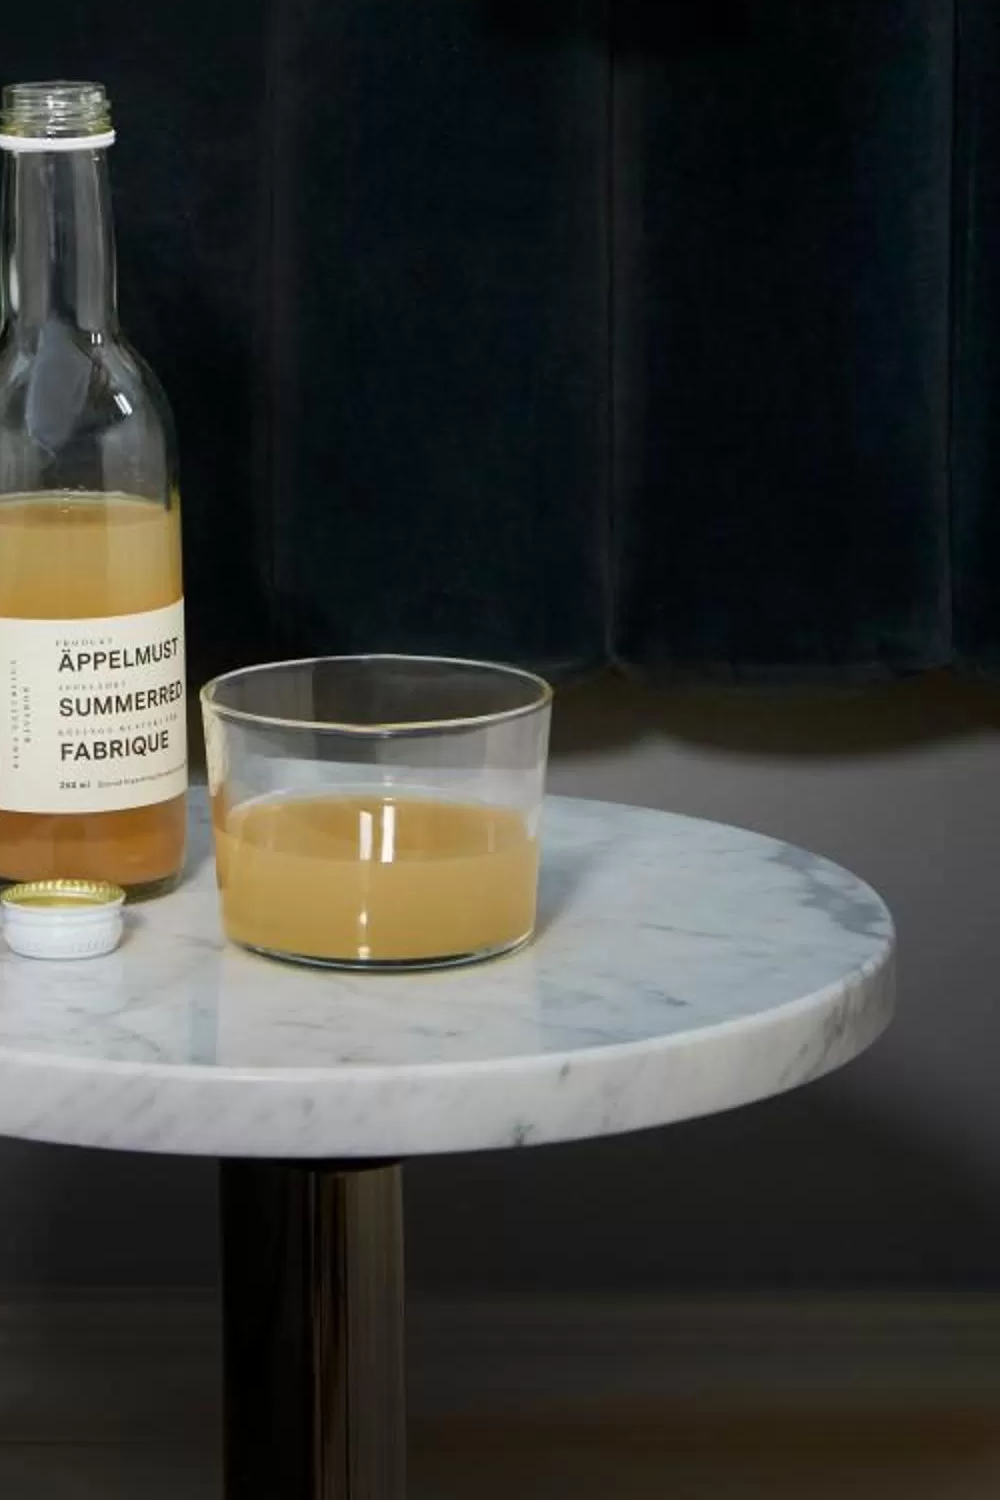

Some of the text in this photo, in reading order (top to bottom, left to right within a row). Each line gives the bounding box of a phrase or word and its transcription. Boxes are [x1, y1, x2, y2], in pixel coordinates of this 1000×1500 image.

[59, 637, 178, 672] ÄPPELMUST
[60, 680, 183, 717] SUMMERRED
[61, 730, 169, 761] FABRIQUE
